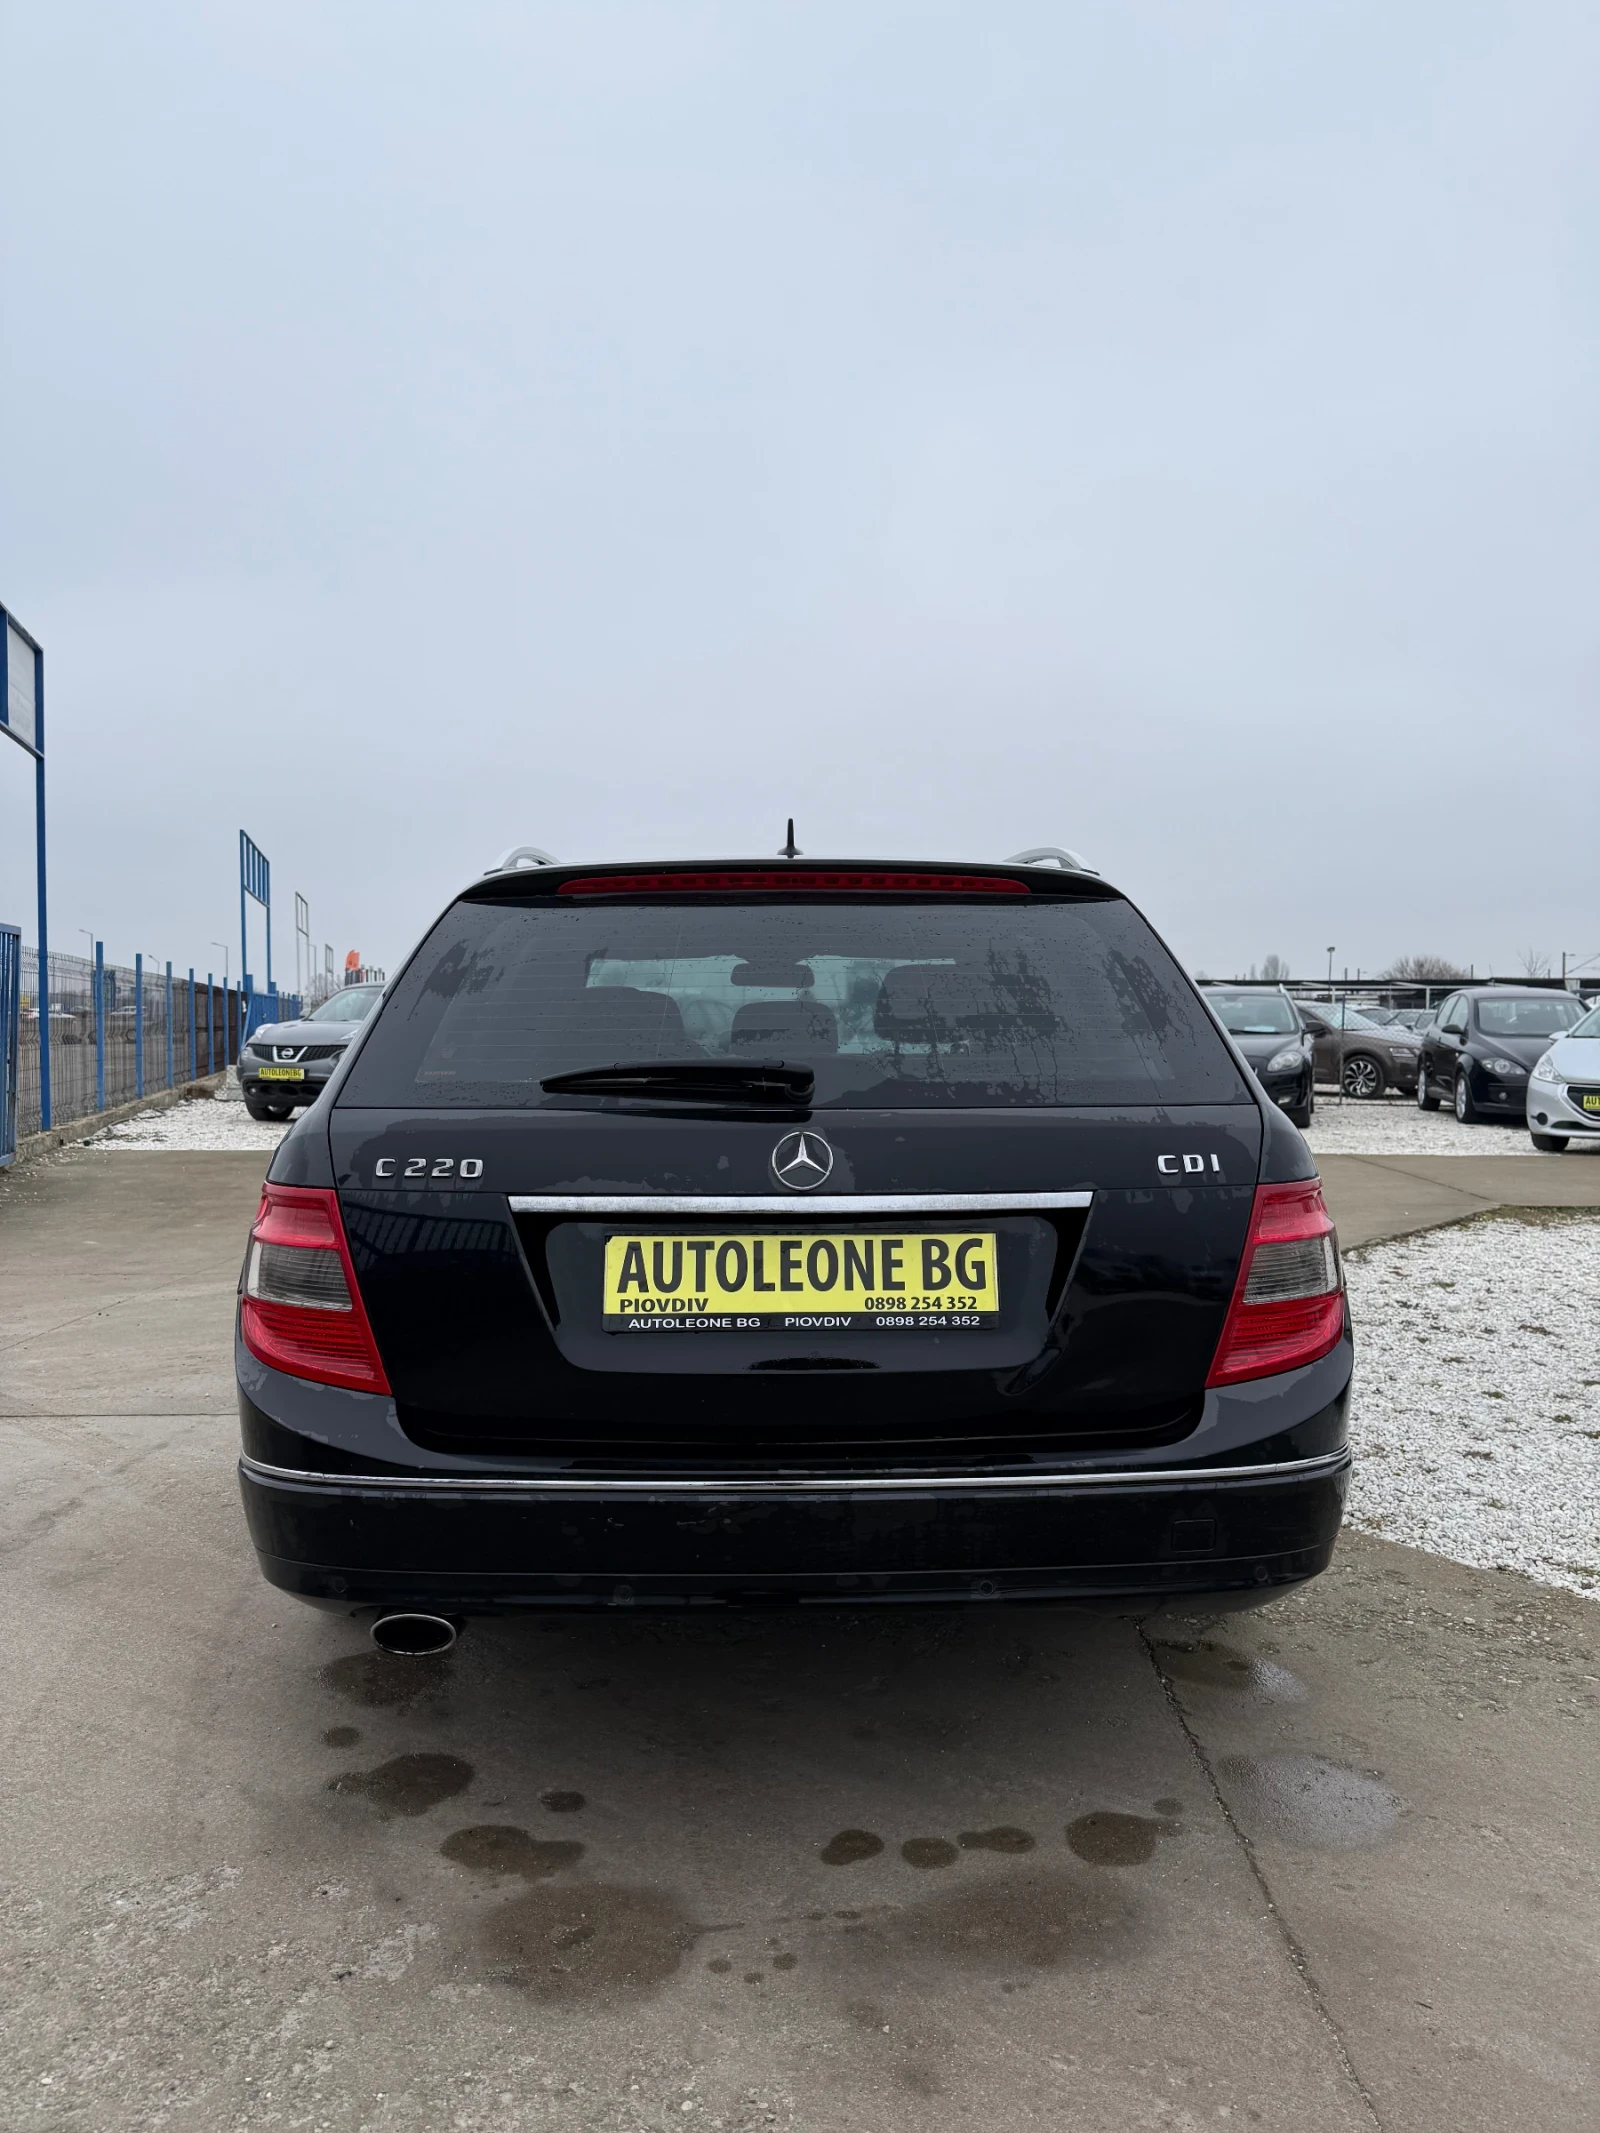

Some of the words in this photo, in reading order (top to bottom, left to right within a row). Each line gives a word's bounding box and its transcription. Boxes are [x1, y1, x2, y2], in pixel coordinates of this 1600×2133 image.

[375, 1158, 397, 1177] C
[404, 1158, 484, 1178] 220
[1157, 1153, 1221, 1174] CDI
[616, 1239, 906, 1294] AUTOLEONE
[920, 1238, 987, 1291] BG
[619, 1298, 709, 1313] PIOVDIV
[864, 1296, 907, 1311] 0898
[910, 1296, 943, 1310] 254
[946, 1296, 978, 1310] 352
[628, 1317, 732, 1329] AUTOLEONE
[736, 1317, 761, 1328] BG
[785, 1316, 852, 1328] PIOVDIV
[875, 1316, 915, 1327] 0898
[918, 1316, 948, 1326] 254
[951, 1315, 981, 1326] 352
